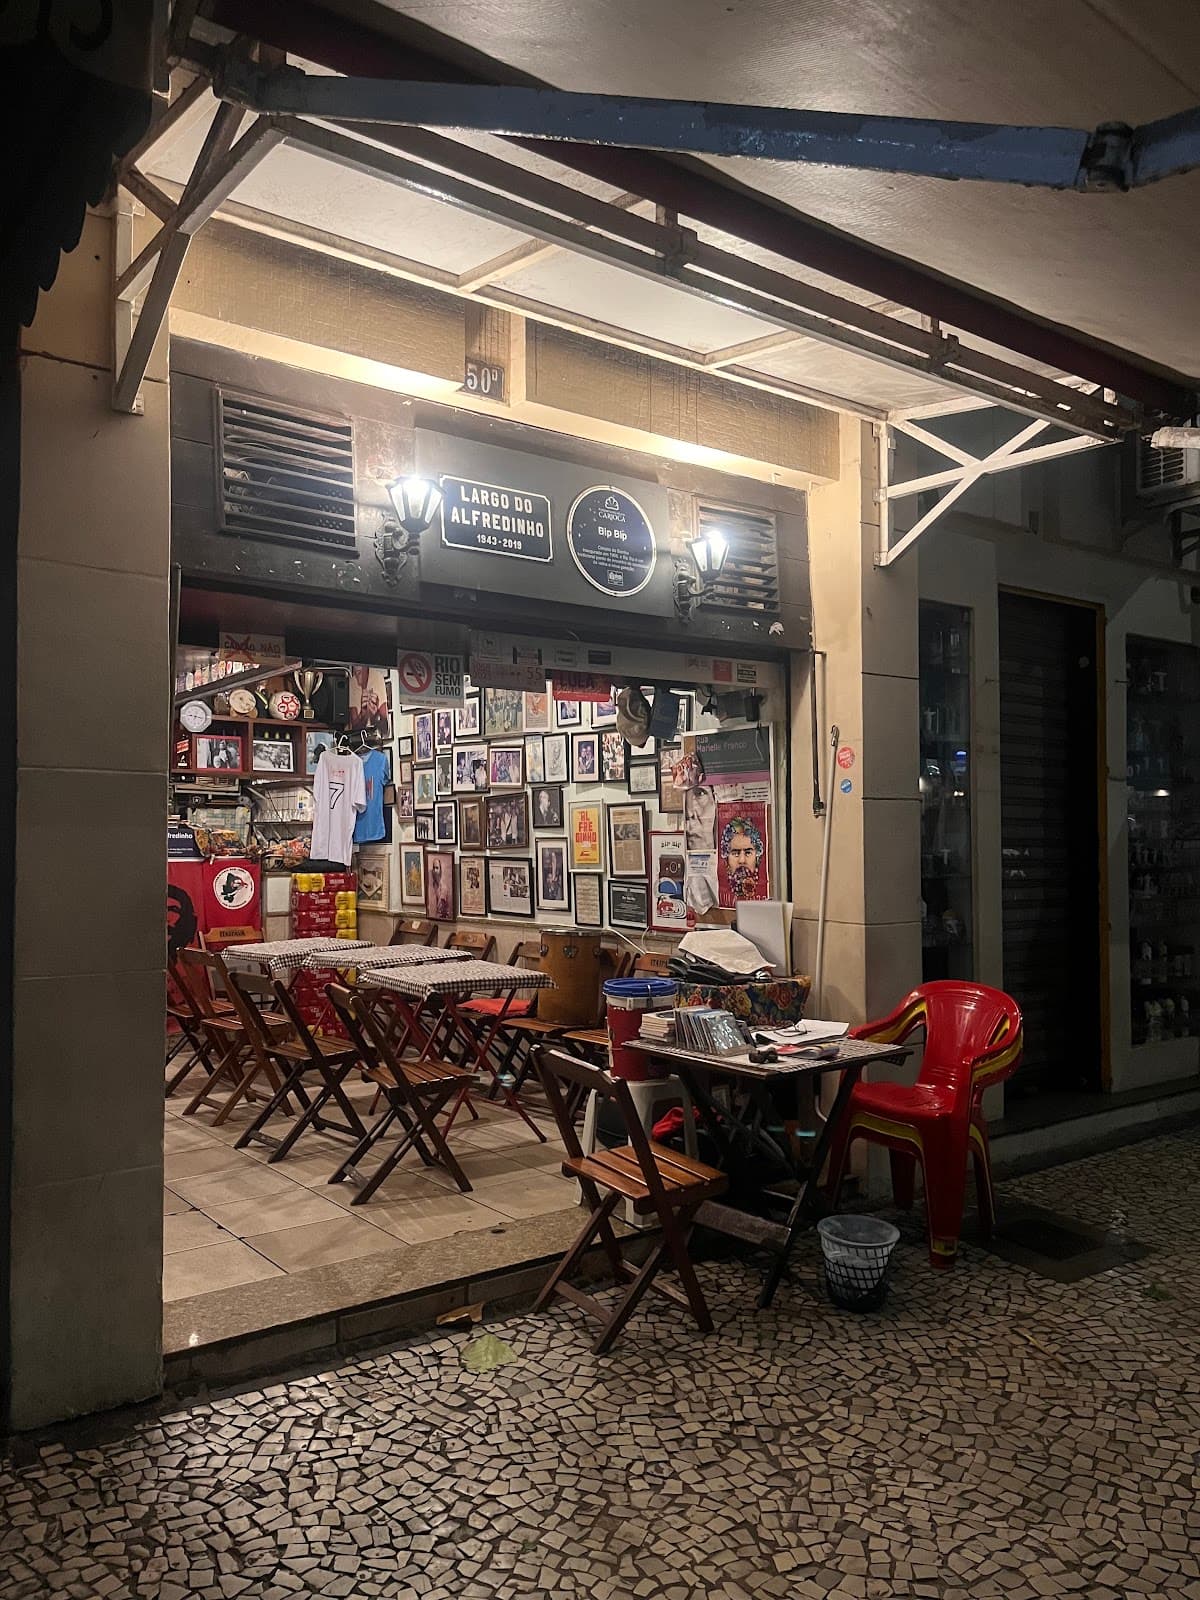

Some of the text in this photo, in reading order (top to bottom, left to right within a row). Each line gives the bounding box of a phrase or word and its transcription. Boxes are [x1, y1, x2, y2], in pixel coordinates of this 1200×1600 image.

[460, 485, 533, 514] LARGO DO
[451, 506, 545, 538] ALFREDINHO
[598, 526, 627, 541] Bip Bip
[434, 655, 461, 674] RIO
[434, 673, 462, 687] SEM
[434, 685, 462, 697] FUMO
[328, 781, 346, 810] 7
